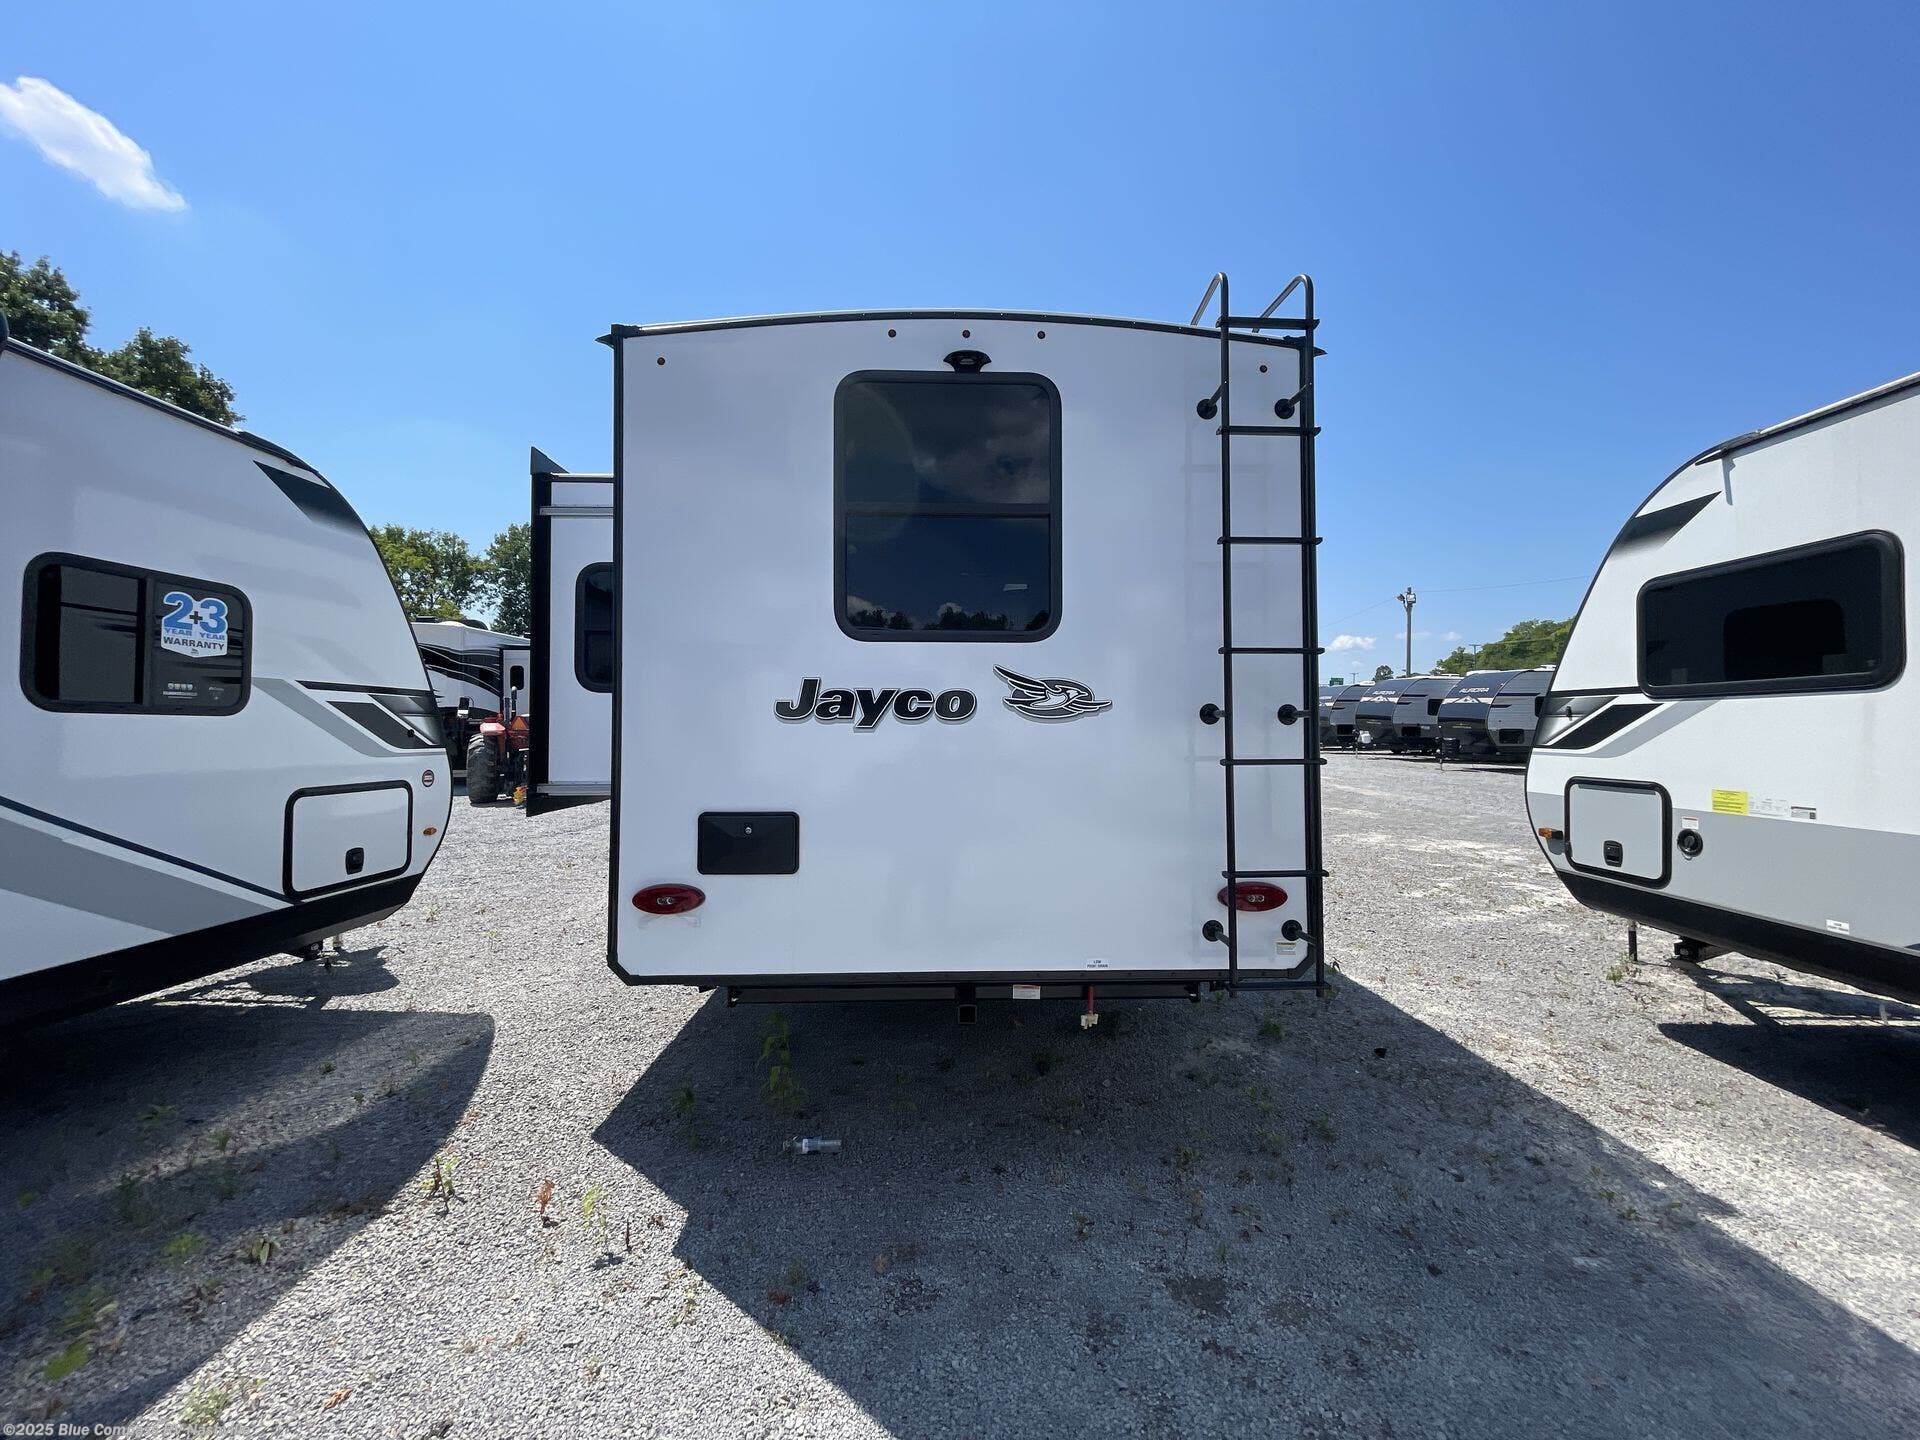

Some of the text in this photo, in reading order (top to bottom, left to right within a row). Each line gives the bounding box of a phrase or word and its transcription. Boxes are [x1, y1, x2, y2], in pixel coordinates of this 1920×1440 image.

[164, 628, 225, 640] YEAR YEAR
[163, 636, 225, 650] WARRANTY
[775, 677, 977, 732] Jayco
